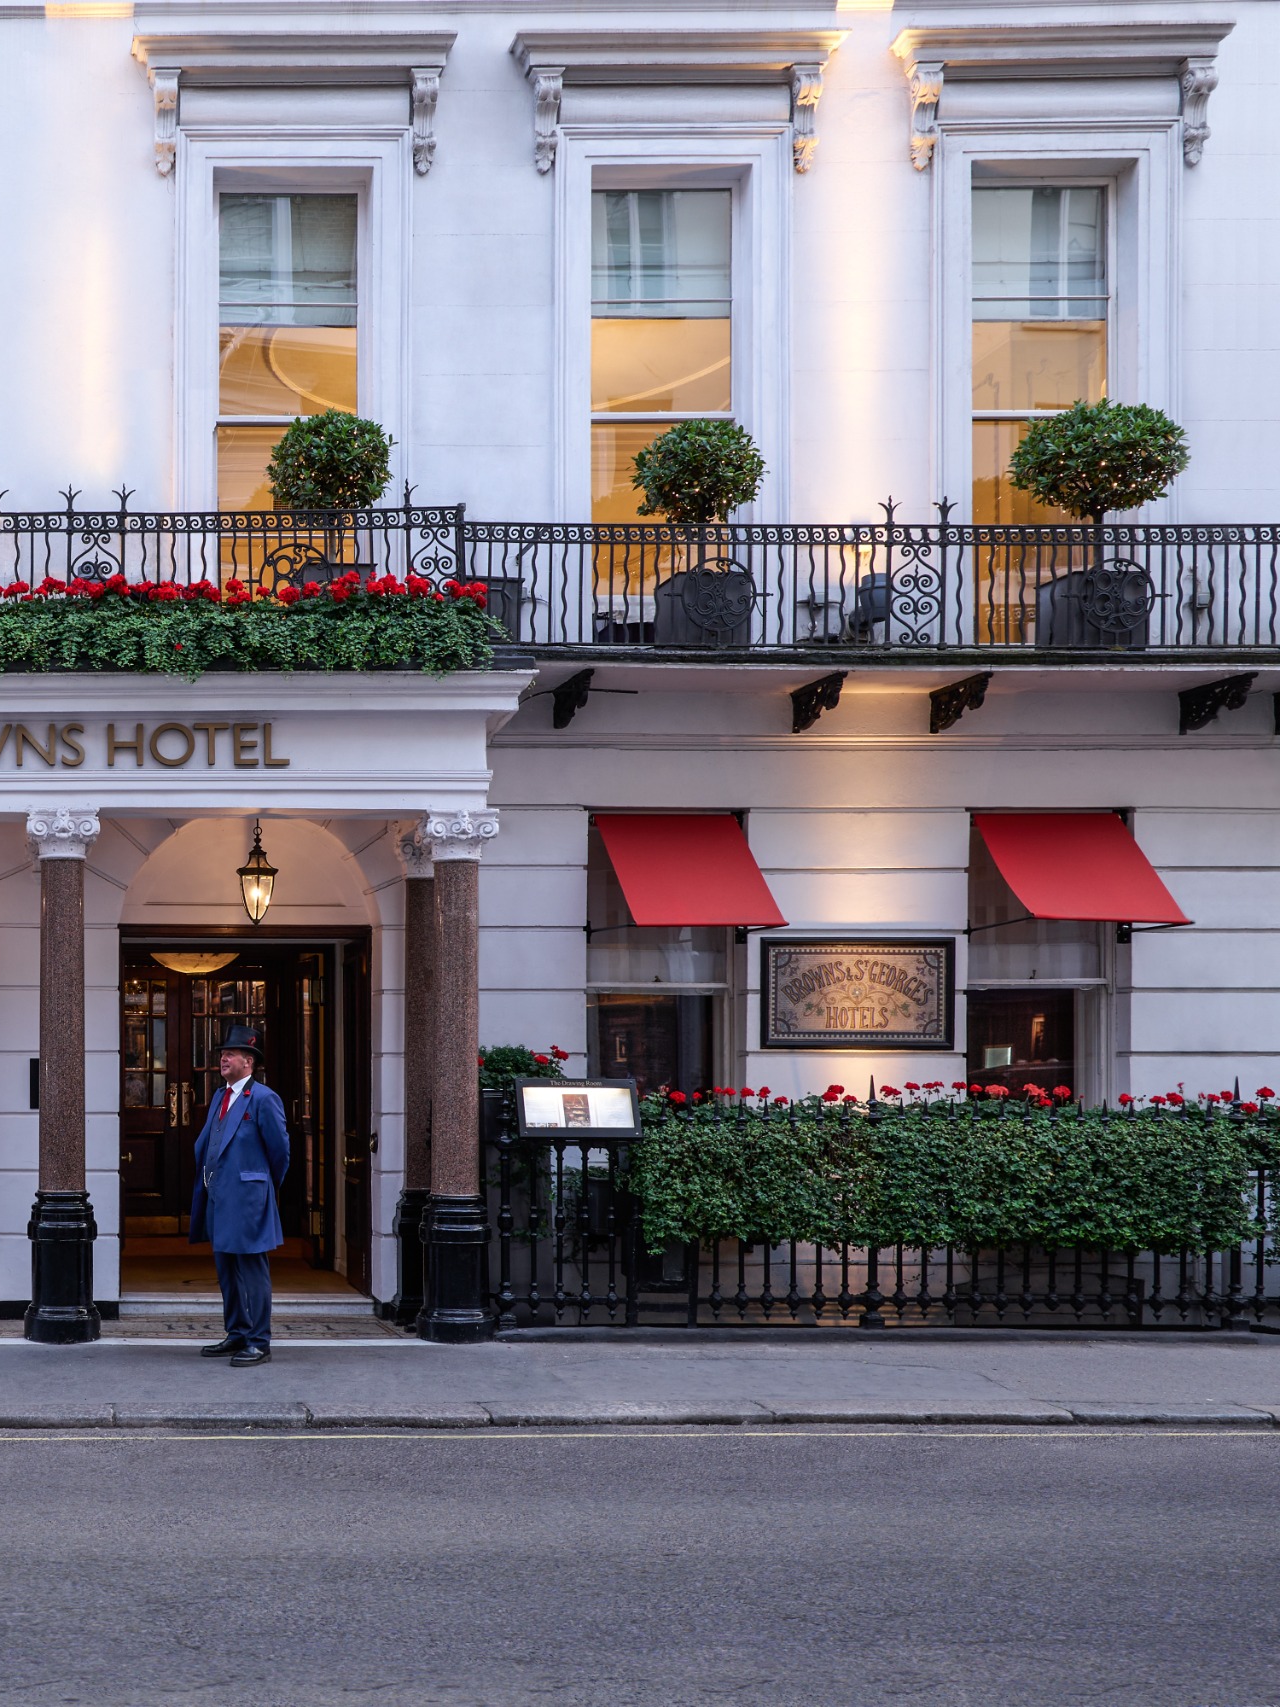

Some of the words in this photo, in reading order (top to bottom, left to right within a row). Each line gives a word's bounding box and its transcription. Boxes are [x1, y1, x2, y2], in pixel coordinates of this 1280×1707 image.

[107, 721, 291, 767] HOTEL
[781, 960, 846, 1006] BROWNS
[846, 966, 854, 981] &
[868, 961, 934, 1007] GEORGES
[825, 1006, 890, 1029] HOTELS
